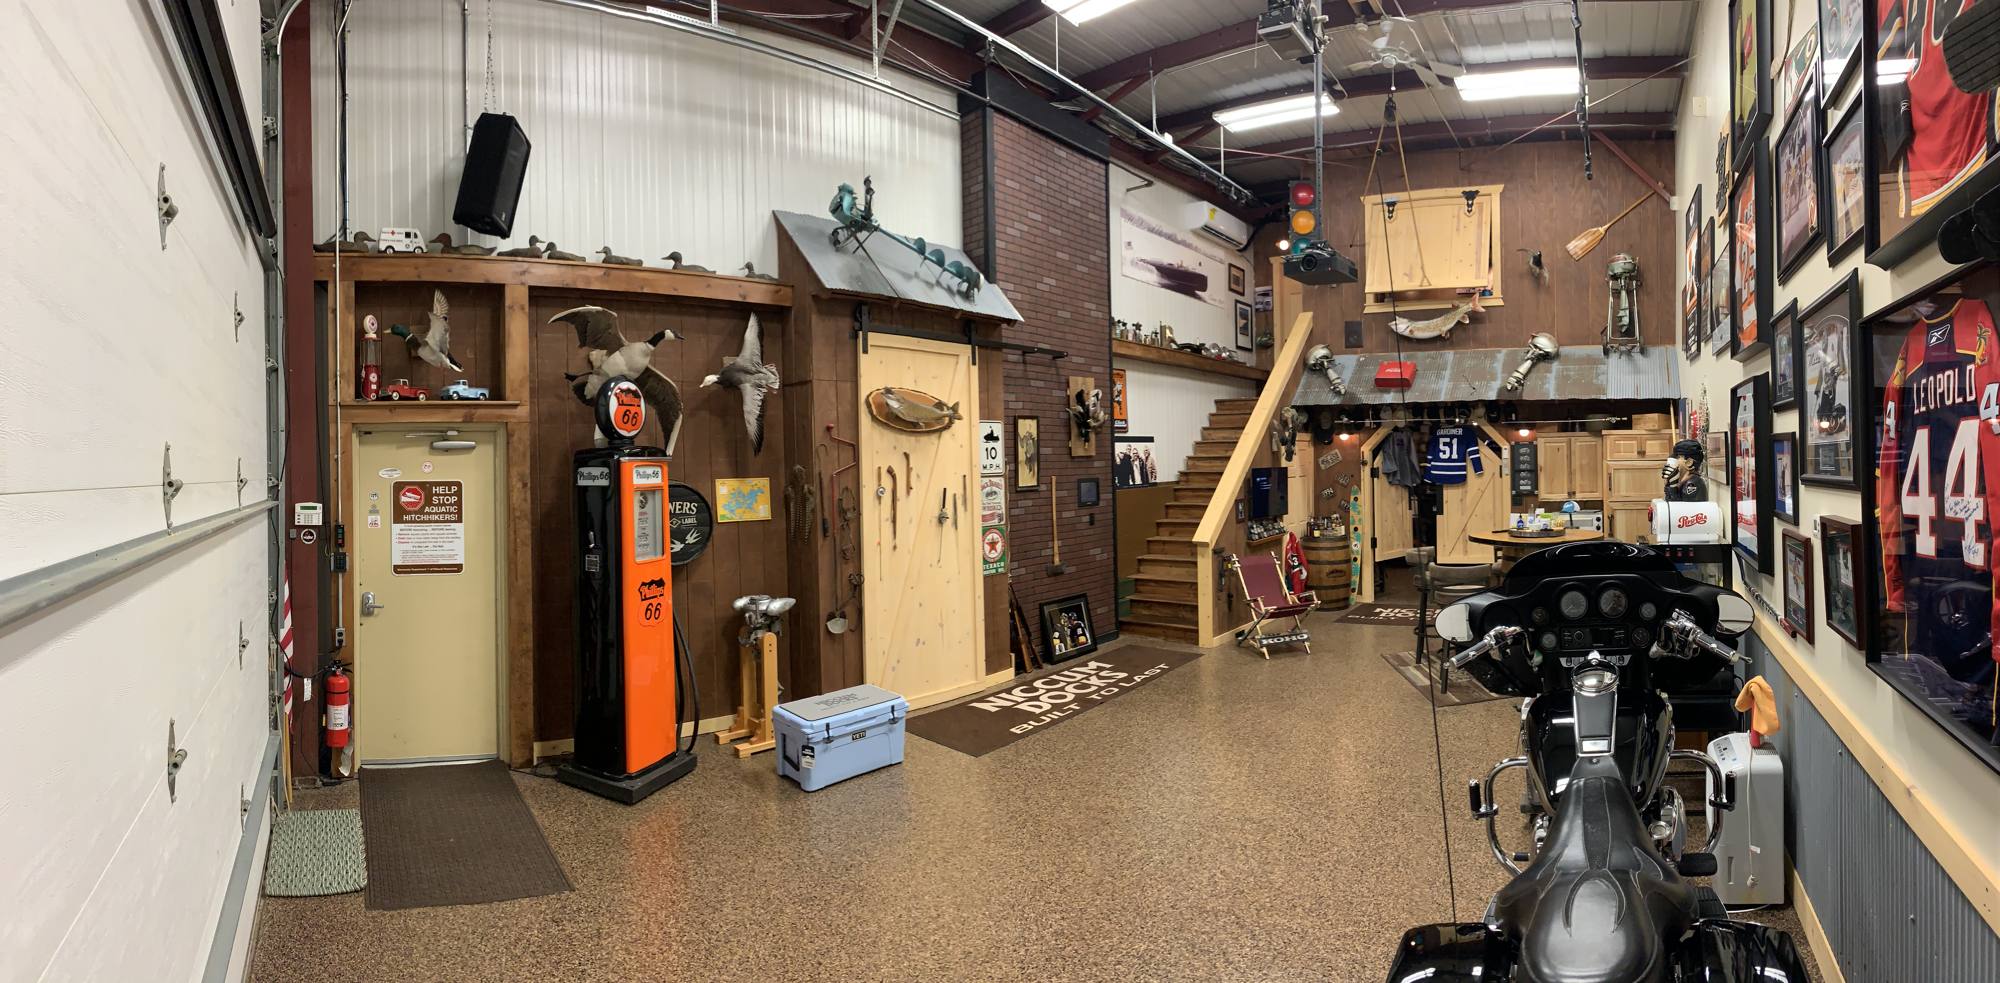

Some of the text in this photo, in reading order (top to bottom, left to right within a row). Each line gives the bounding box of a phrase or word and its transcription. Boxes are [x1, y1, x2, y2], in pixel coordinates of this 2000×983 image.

[1913, 363, 1976, 415] LEOPOLD
[622, 409, 639, 427] 66
[1436, 427, 1463, 436] GARDINER
[985, 446, 998, 460] 10
[1438, 437, 1458, 460] 51
[576, 470, 610, 483] Phillips 66
[635, 469, 653, 480] Phillips
[432, 486, 458, 494] HELP
[1901, 418, 1985, 567] 44
[432, 496, 458, 504] STOP
[983, 561, 1005, 570] TEXACO
[644, 602, 662, 621] 66
[968, 660, 1114, 713] NICCUM
[1012, 669, 1129, 715] DOCKS
[1009, 663, 1170, 735] BUILT TO LAST
[852, 731, 866, 740] YETI
